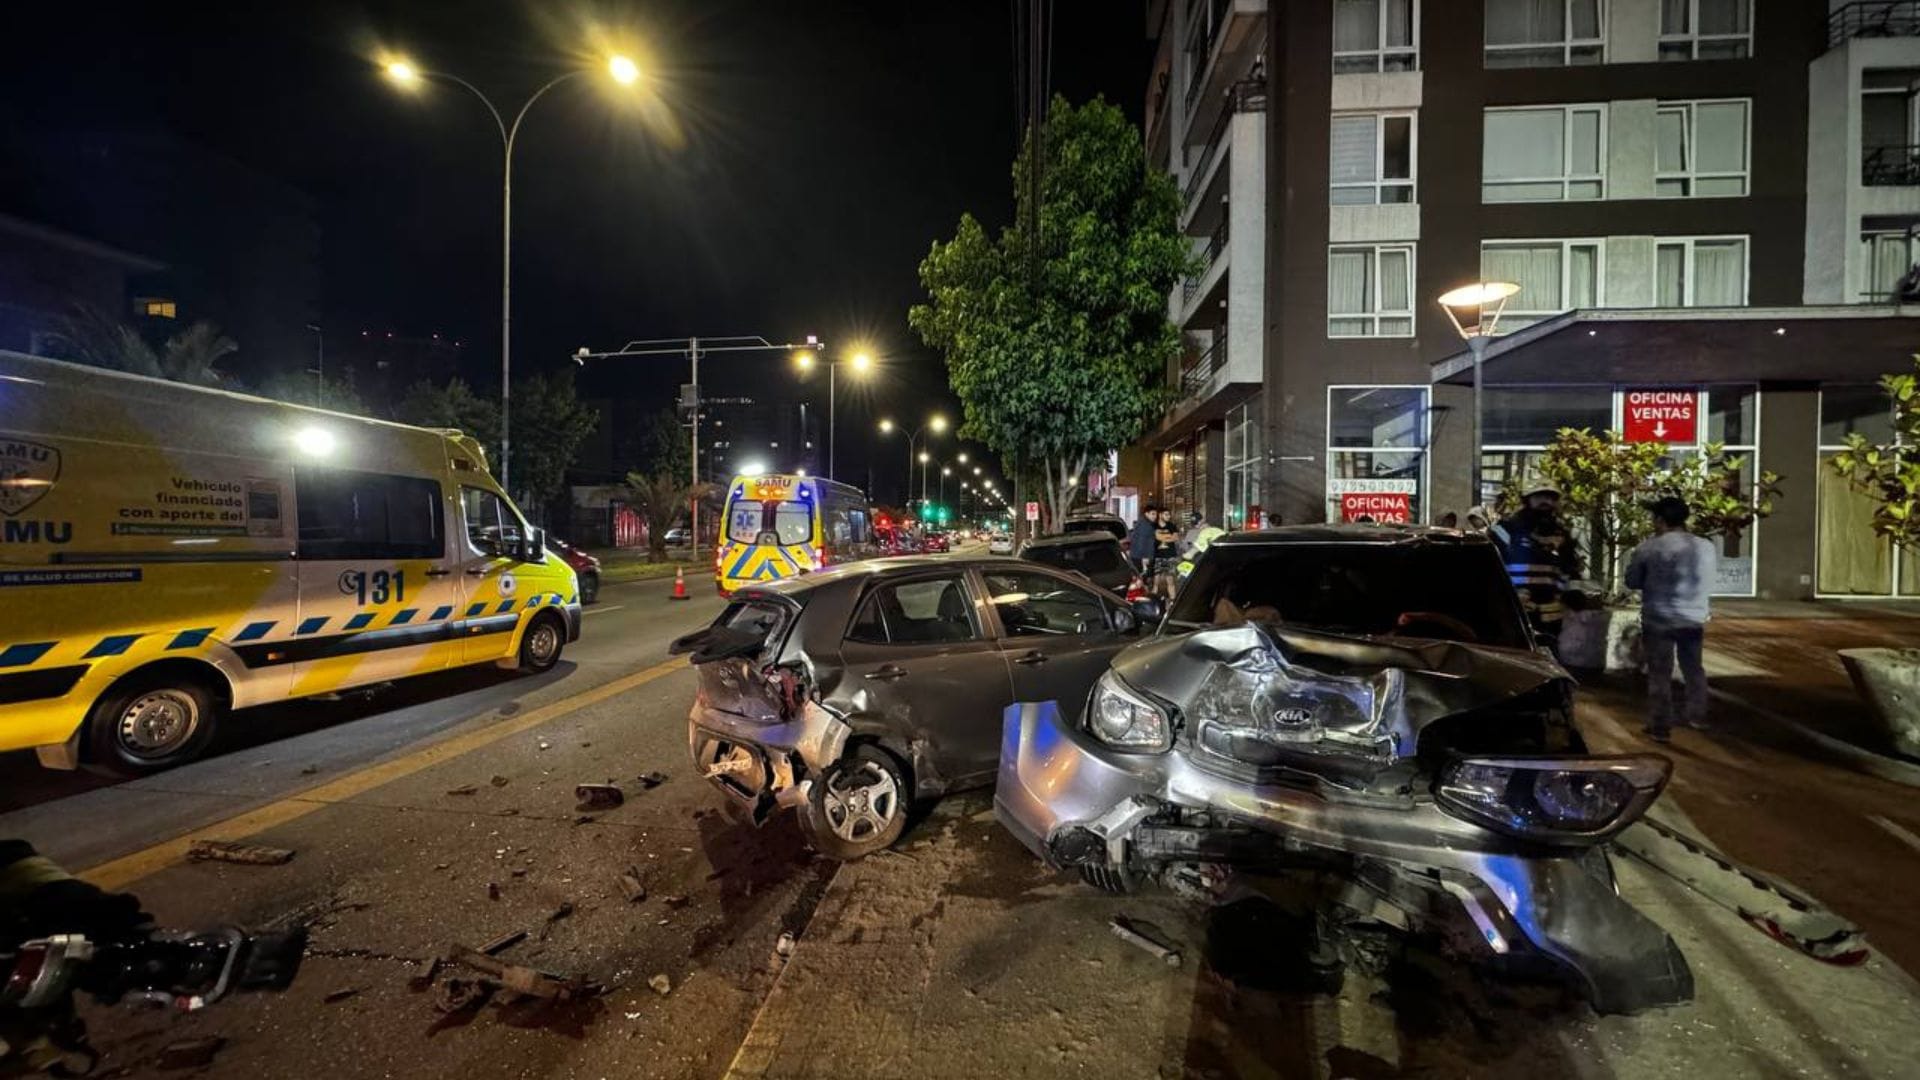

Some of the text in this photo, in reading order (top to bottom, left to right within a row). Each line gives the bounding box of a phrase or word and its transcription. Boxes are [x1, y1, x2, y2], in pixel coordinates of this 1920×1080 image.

[1630, 392, 1693, 404] OFICINA
[1632, 407, 1690, 420] VENTAS
[0, 443, 49, 460] MU
[755, 478, 792, 488] SAMU
[156, 492, 243, 507] financiado
[1346, 497, 1406, 509] OFICINA
[119, 507, 243, 522] con aporte del
[0, 520, 73, 544] MU
[353, 569, 404, 606] 131
